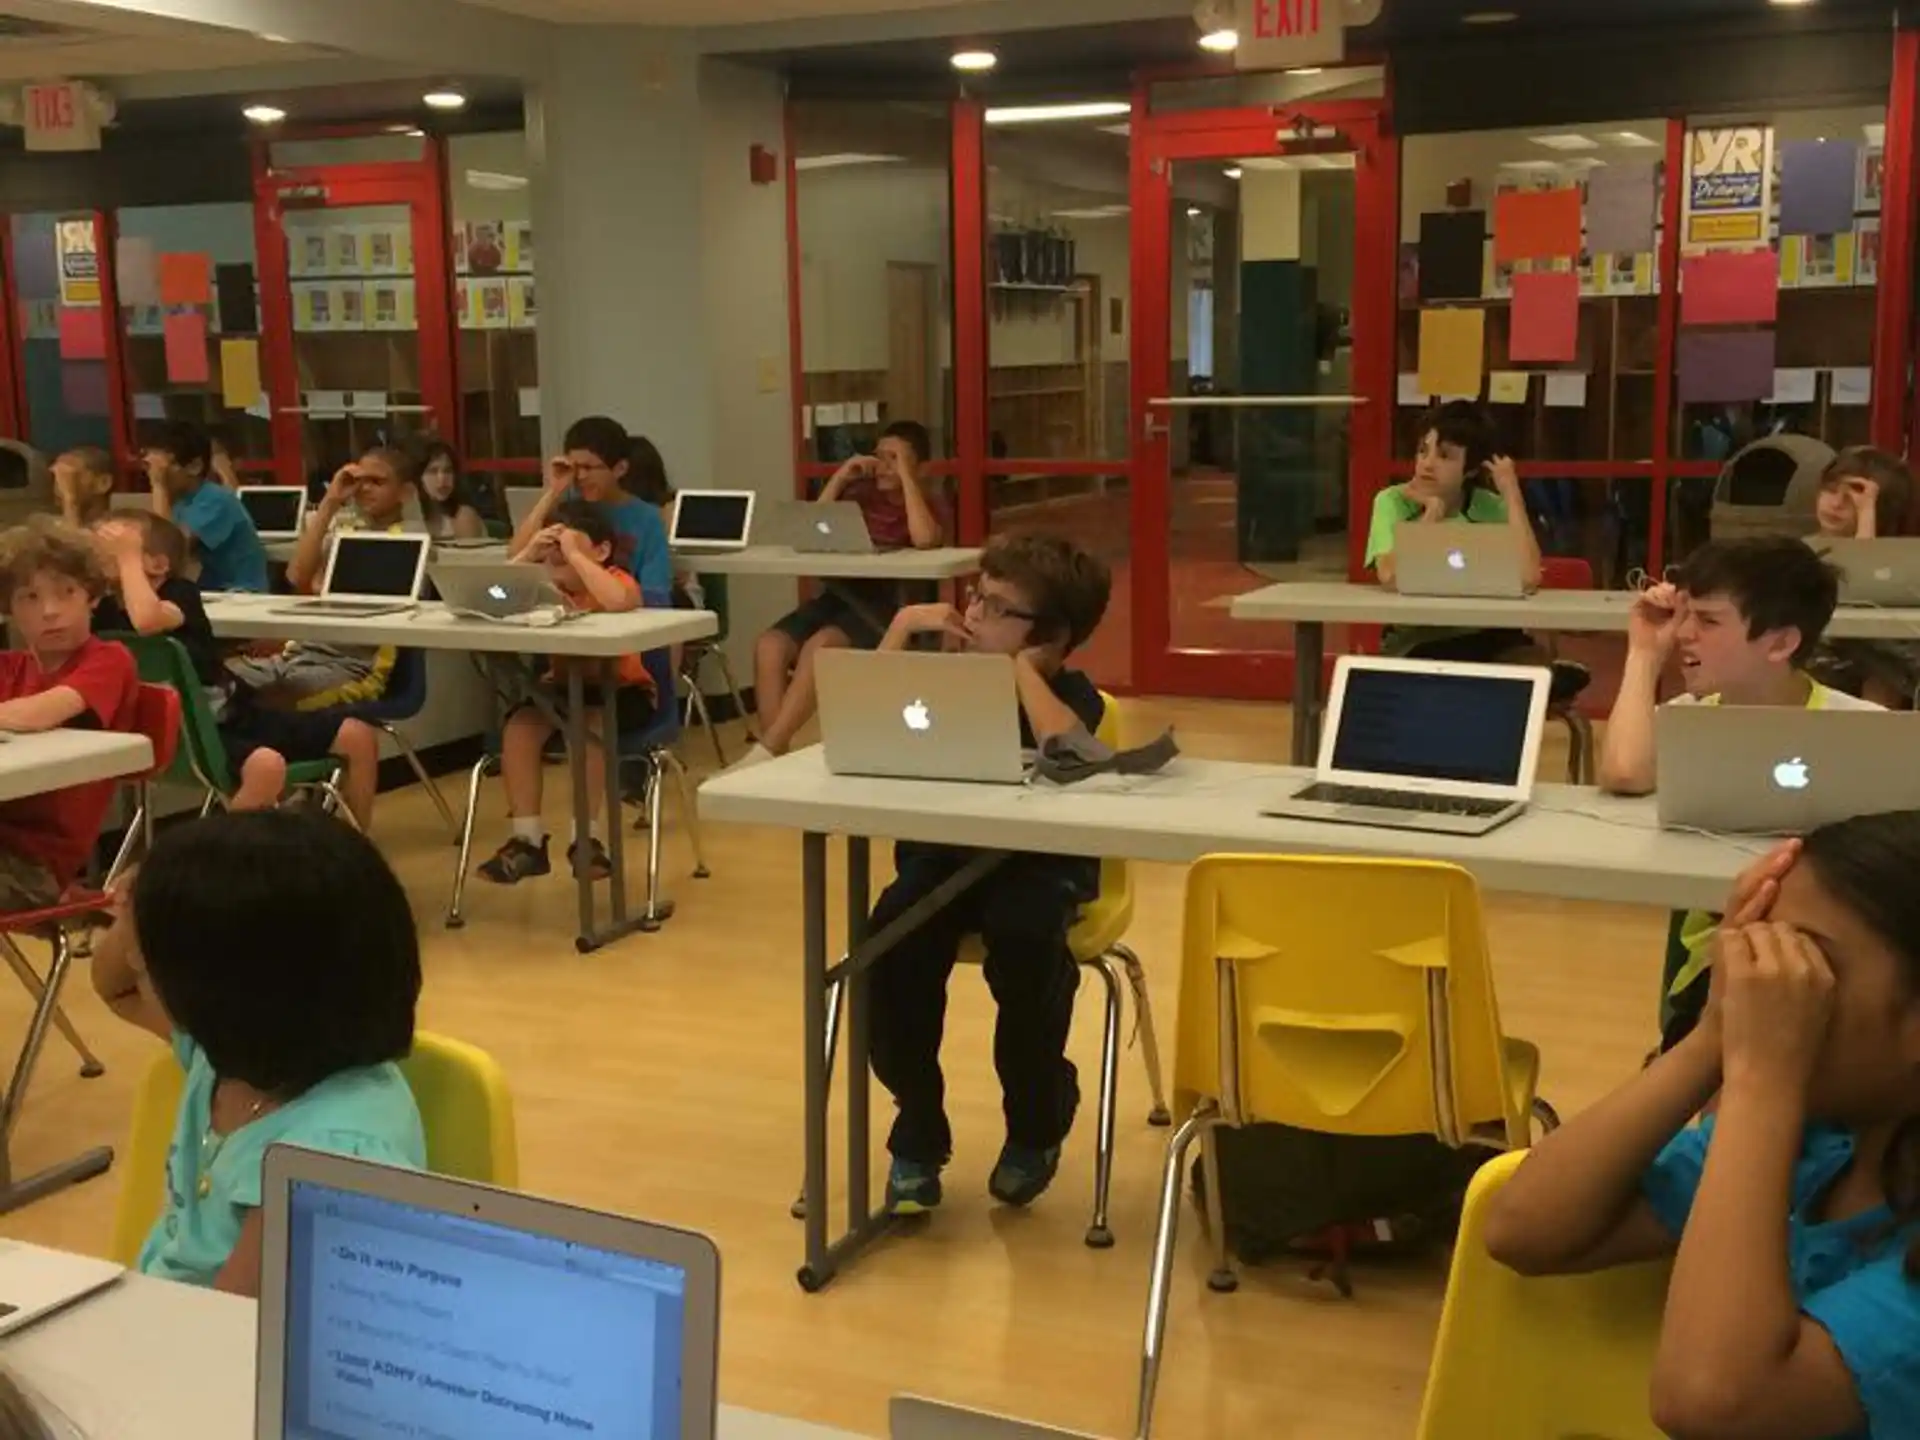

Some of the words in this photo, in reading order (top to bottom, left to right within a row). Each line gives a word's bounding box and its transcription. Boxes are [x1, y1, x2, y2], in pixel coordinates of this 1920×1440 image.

[1253, 0, 1320, 37] EXIT
[1692, 127, 1762, 176] YR
[375, 1257, 404, 1273] with
[406, 1263, 462, 1288] Purpose
